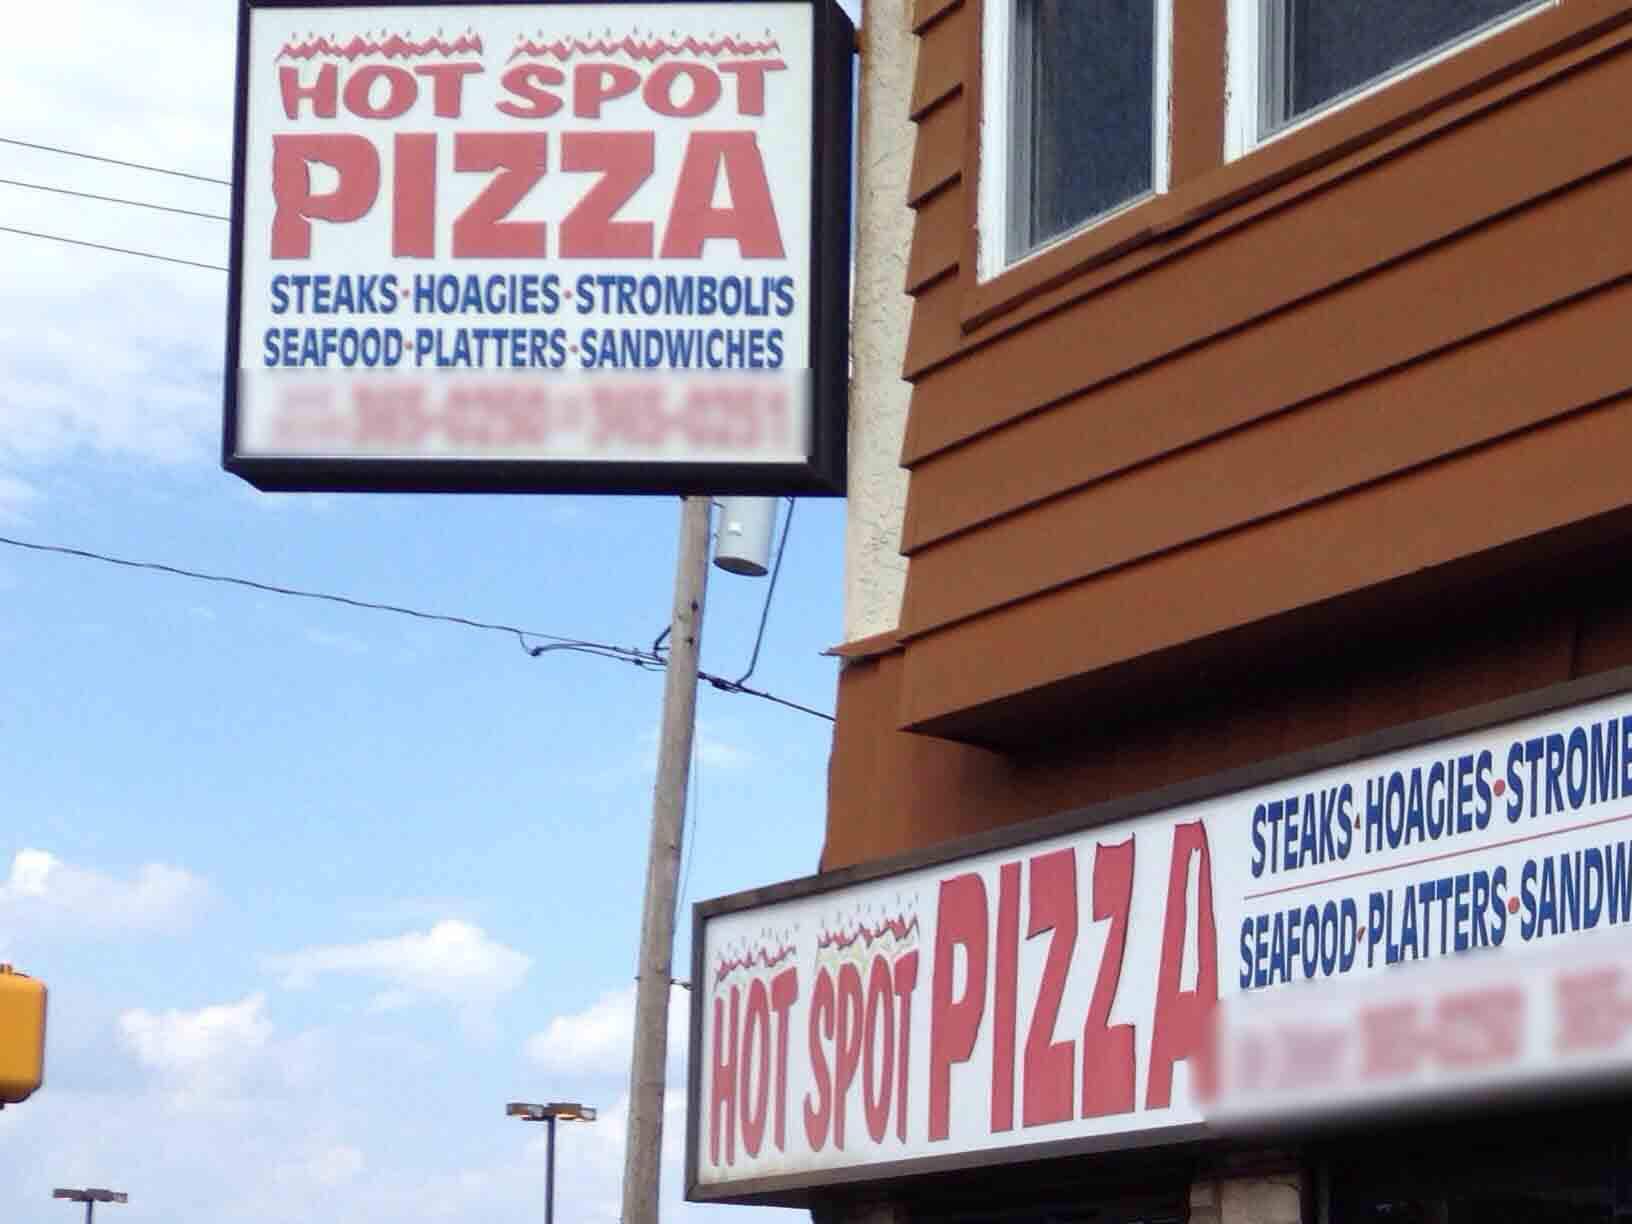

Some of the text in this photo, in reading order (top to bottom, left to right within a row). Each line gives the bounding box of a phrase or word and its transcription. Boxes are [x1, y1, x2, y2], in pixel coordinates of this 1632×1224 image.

[278, 60, 787, 120] HOT SPOT
[270, 131, 786, 259] PIZZA
[264, 327, 785, 369] SEAFOOD PLATTERS SANDWICHES
[270, 274, 795, 317] STEAKS HOAGIES STROMBOLI'S
[1251, 783, 1353, 879] STEAKS
[1364, 749, 1493, 854] HOAGIES
[1239, 897, 1358, 990] SEAFOOD
[1367, 865, 1507, 968] PLATTERS
[708, 965, 800, 1168] HOT
[802, 947, 920, 1154] SPOT
[927, 817, 1220, 1143] PIZZA
